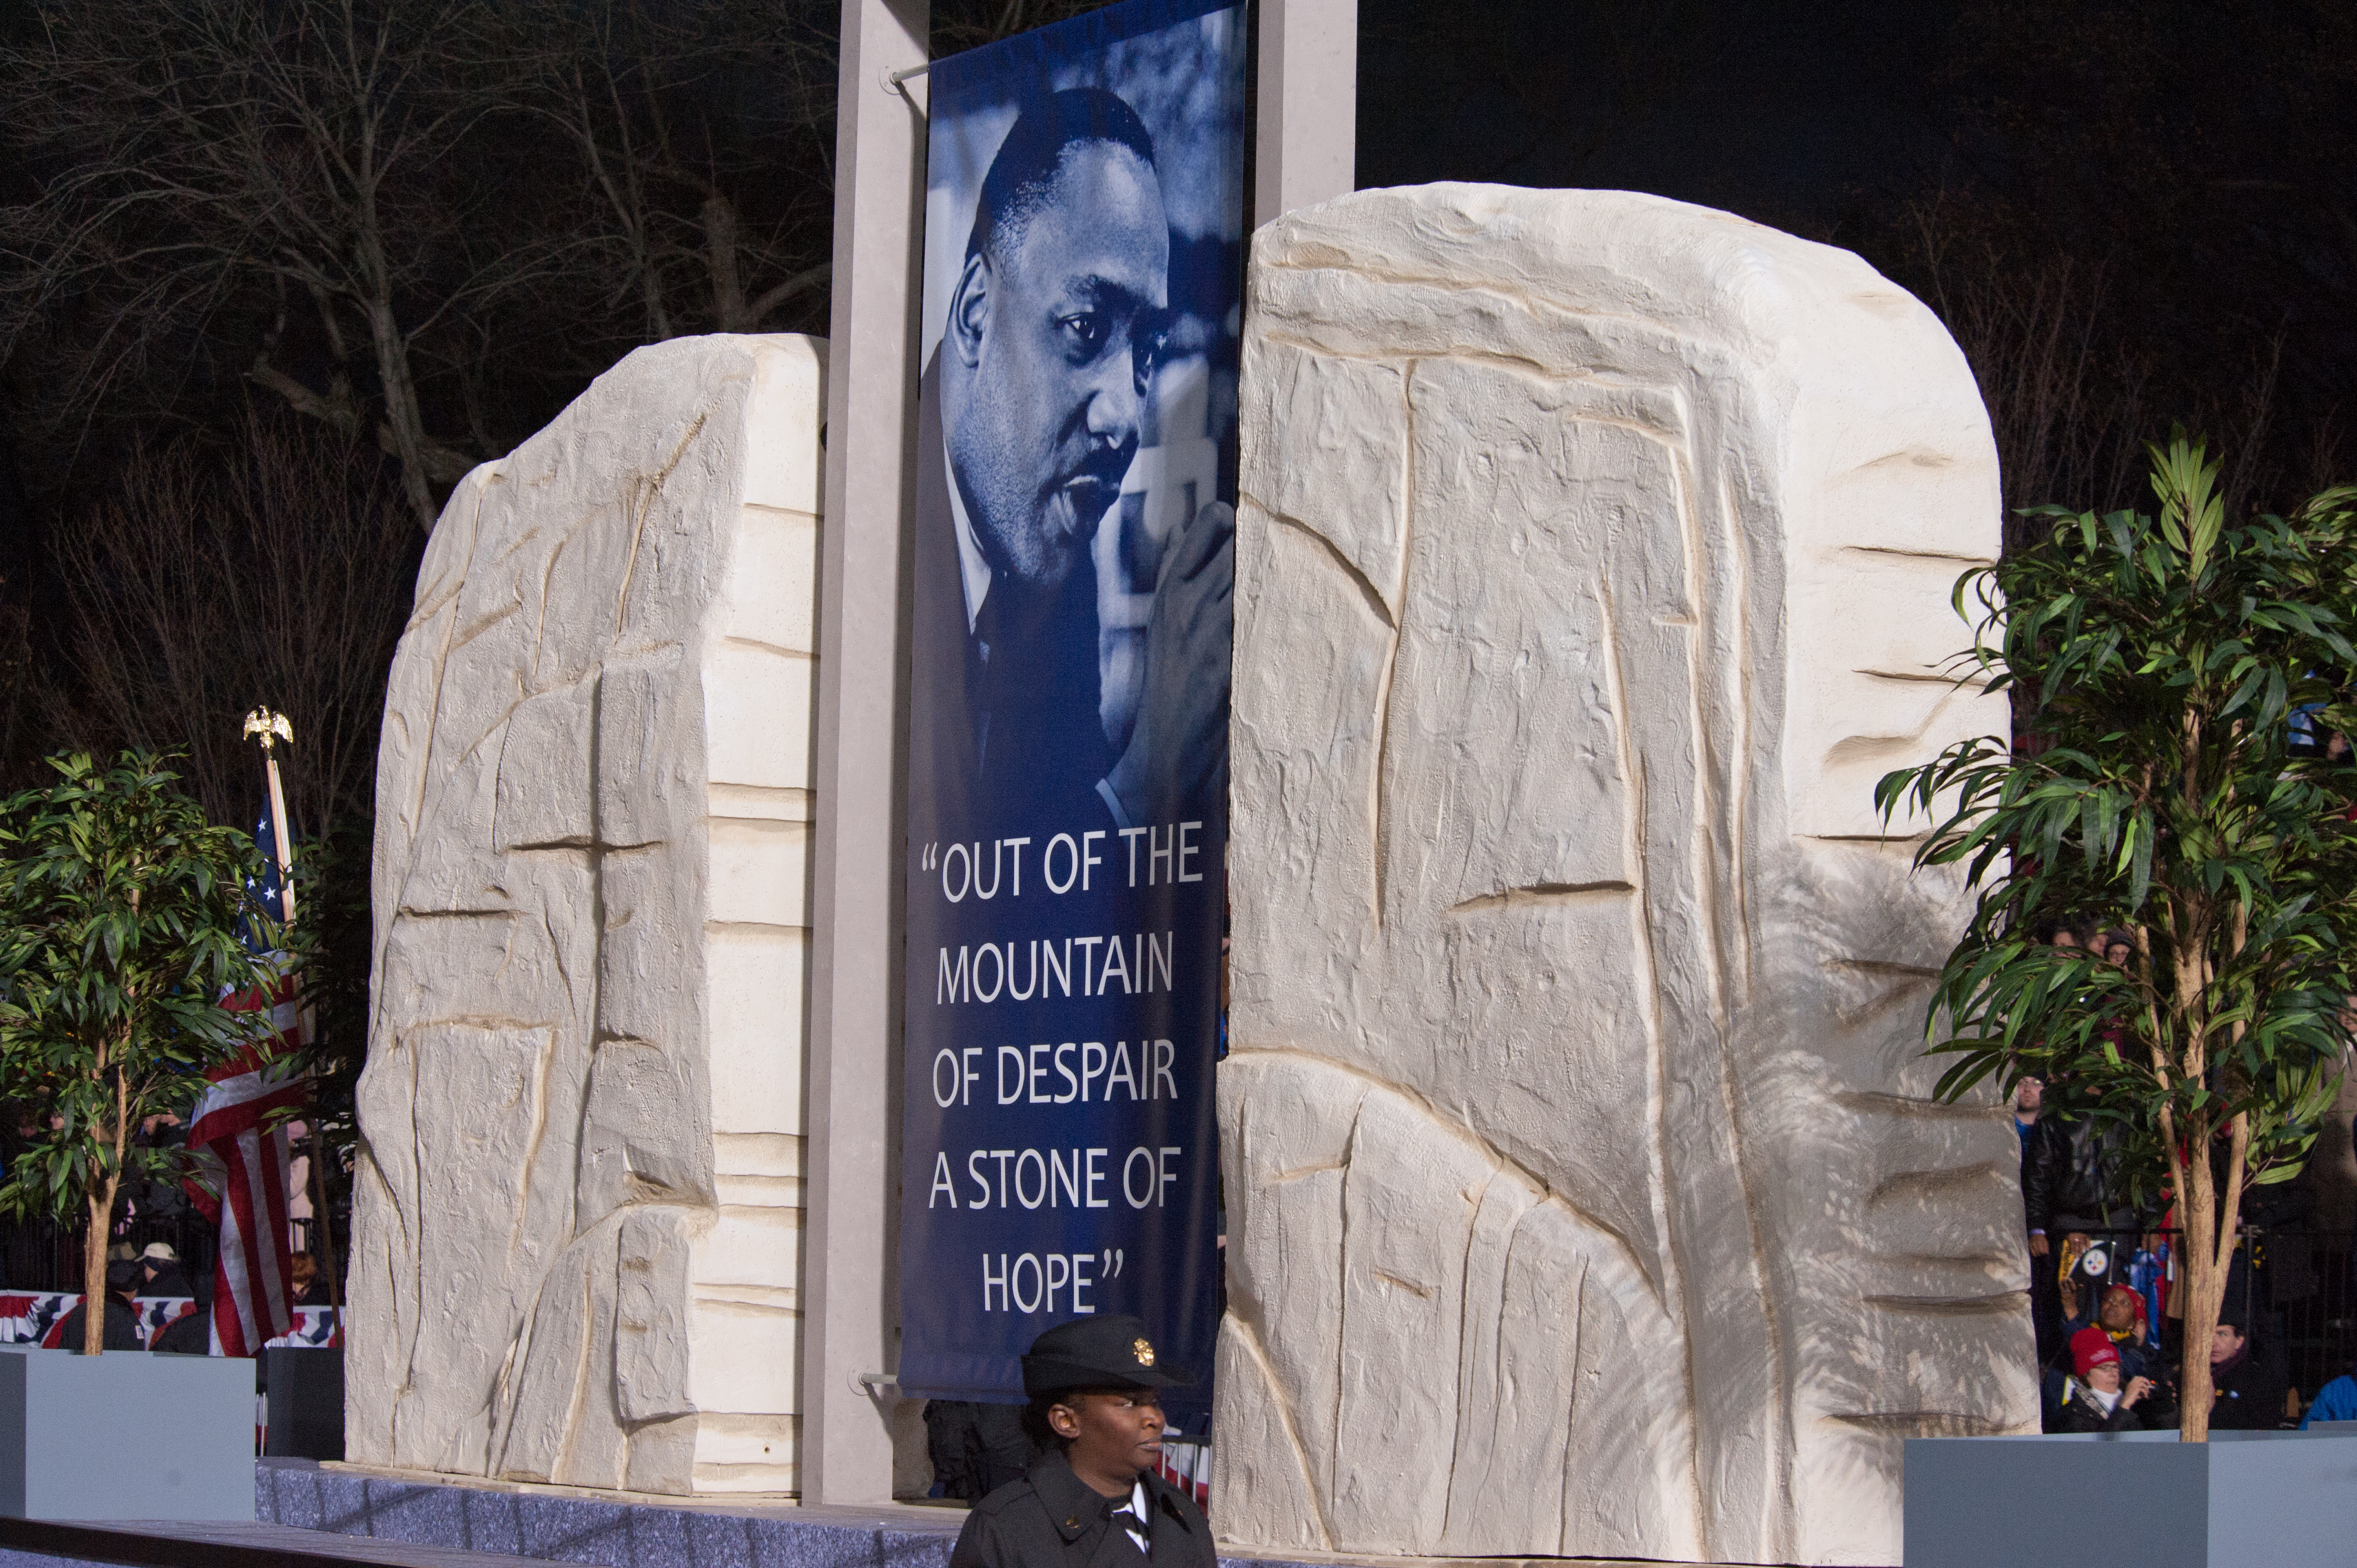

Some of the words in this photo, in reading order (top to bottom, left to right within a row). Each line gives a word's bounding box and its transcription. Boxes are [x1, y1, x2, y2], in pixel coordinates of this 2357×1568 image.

[922, 837, 1031, 903] “OUT
[1044, 830, 1106, 894] OF
[1118, 821, 1203, 887] THE
[937, 931, 1172, 1005] MOUNTAIN
[933, 1047, 982, 1108] OF
[998, 1039, 1177, 1105] DESPAIR
[929, 1151, 958, 1209] A
[969, 1148, 1109, 1210] STONE
[1123, 1147, 1181, 1209] OF
[982, 1249, 1123, 1314] HOPE”
